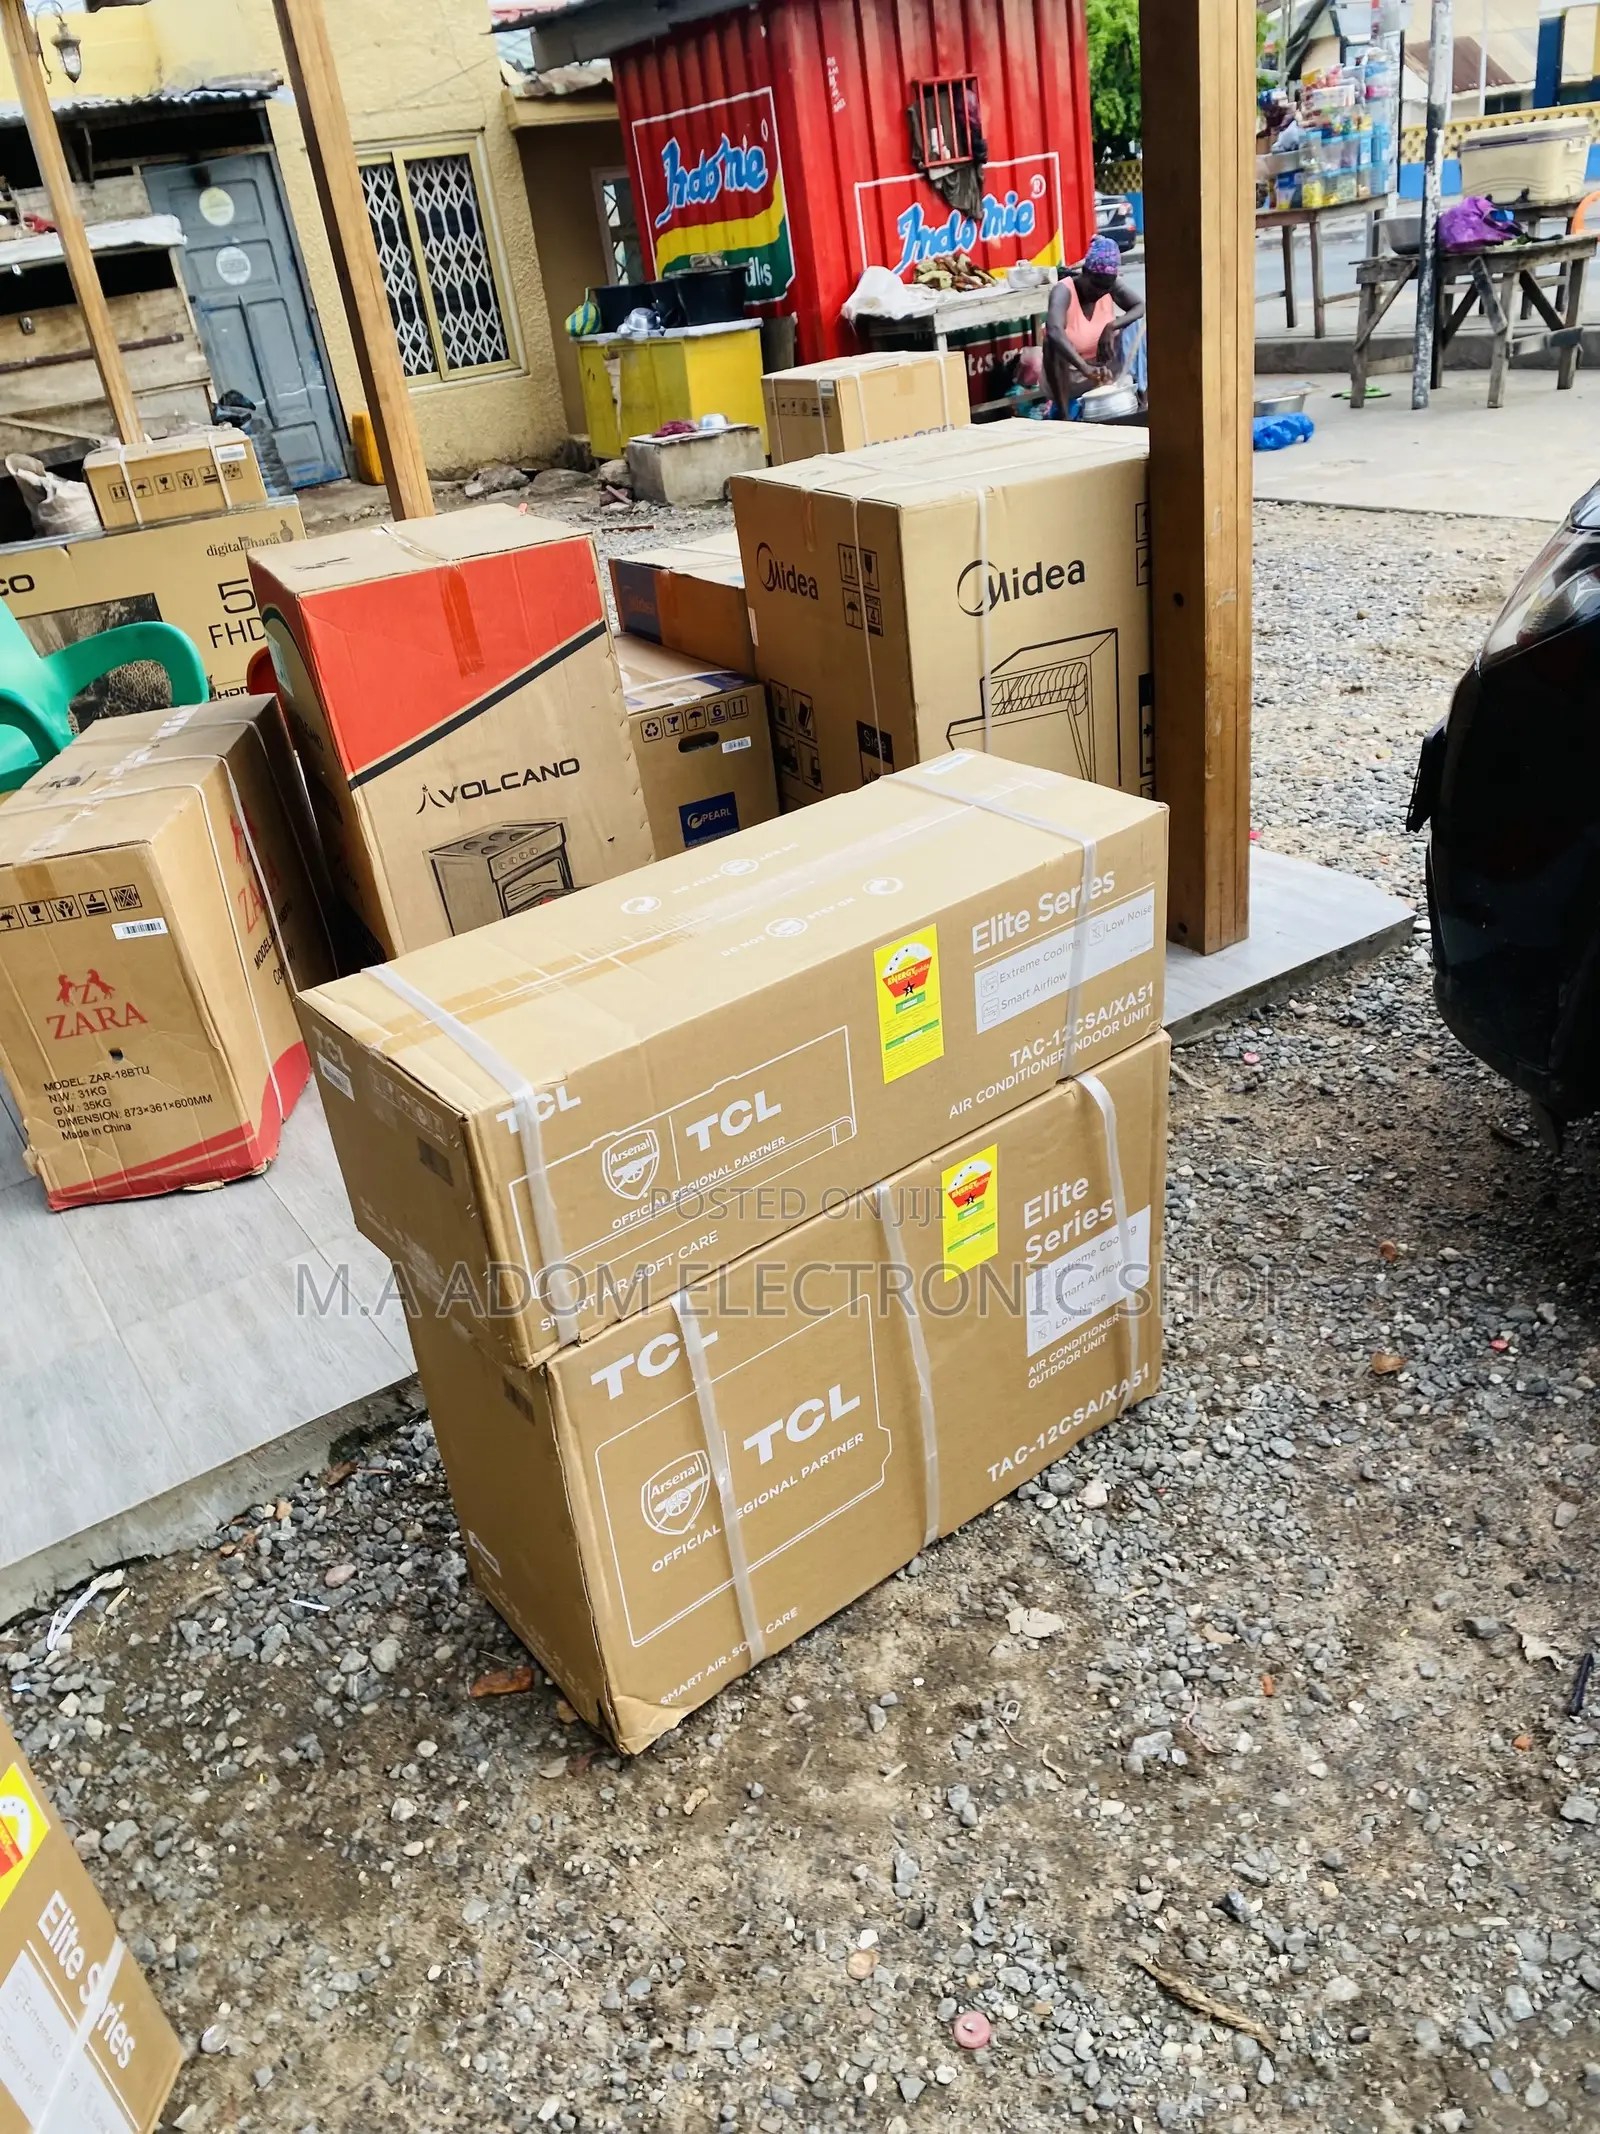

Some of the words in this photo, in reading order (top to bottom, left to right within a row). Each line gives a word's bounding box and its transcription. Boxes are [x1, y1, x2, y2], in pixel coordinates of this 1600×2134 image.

[893, 190, 1035, 277] Indomie
[759, 545, 819, 602] Midea
[966, 556, 1087, 613] Midea
[438, 757, 581, 804] VOLCANO
[702, 807, 732, 823] PEARL
[237, 854, 282, 935] ZAA
[1105, 916, 1125, 933] Low
[1127, 904, 1153, 921] Noise
[972, 909, 1031, 955] Elite
[887, 965, 917, 986] ENERGY
[999, 957, 1040, 984] Extreme
[1043, 938, 1082, 962] Cooling
[1000, 988, 1031, 1011] Smart
[1032, 970, 1068, 993] Airflow
[46, 1001, 149, 1041] ZARA
[1009, 981, 1154, 1069] TAC-12CSA/XA51
[311, 1025, 353, 1073] TCL
[949, 1097, 973, 1119] AIR
[976, 1046, 1067, 1104] CONDITIONER
[1123, 1003, 1152, 1027] UNIT
[44, 1076, 87, 1092] MODEL:
[88, 1065, 151, 1084] ZAR-18BTU
[77, 1085, 108, 1099] 31KG
[83, 1098, 112, 1112] 35KG
[57, 1110, 122, 1128] DIMENSION:
[61, 1128, 91, 1141] Made
[91, 1125, 102, 1136] in
[102, 1121, 132, 1134] China
[496, 1085, 582, 1134] TCL
[685, 1089, 782, 1152] TCL
[610, 1138, 652, 1165] Arsenal
[611, 1194, 669, 1230] OFFICIAL
[671, 1163, 733, 1202] REGIONAL
[734, 1135, 787, 1169] PARTNER
[1024, 1177, 1089, 1230] Elite
[1024, 1198, 1114, 1264] Series
[1055, 1249, 1097, 1279] Extreme
[1099, 1224, 1138, 1253] Coog
[540, 1292, 596, 1332] SRT
[634, 1253, 675, 1283] SOFT
[678, 1230, 719, 1259] CARE
[1055, 1280, 1086, 1305] Smart
[1087, 1257, 1124, 1286] Airflow
[1055, 1314, 1076, 1330] Low
[1079, 1292, 1107, 1314] Noise
[590, 1330, 719, 1401] TC
[1028, 1358, 1047, 1377] AIR
[1048, 1313, 1120, 1363] CONDITIONER
[1028, 1349, 1081, 1390] OUTDOOR
[1083, 1332, 1108, 1354] UNIT
[743, 1384, 861, 1466] TCL
[986, 1362, 1151, 1483] TAC-12CSA/XA51
[650, 1460, 699, 1499] Arsenal
[651, 1524, 722, 1573] OFFICIAL
[735, 1475, 799, 1521] EGIONAL
[801, 1432, 864, 1479] PARTNER
[660, 1671, 703, 1705] SMART
[765, 1606, 798, 1634] CARE
[37, 1889, 86, 1980] Elite
[79, 1961, 136, 2070] Sries
